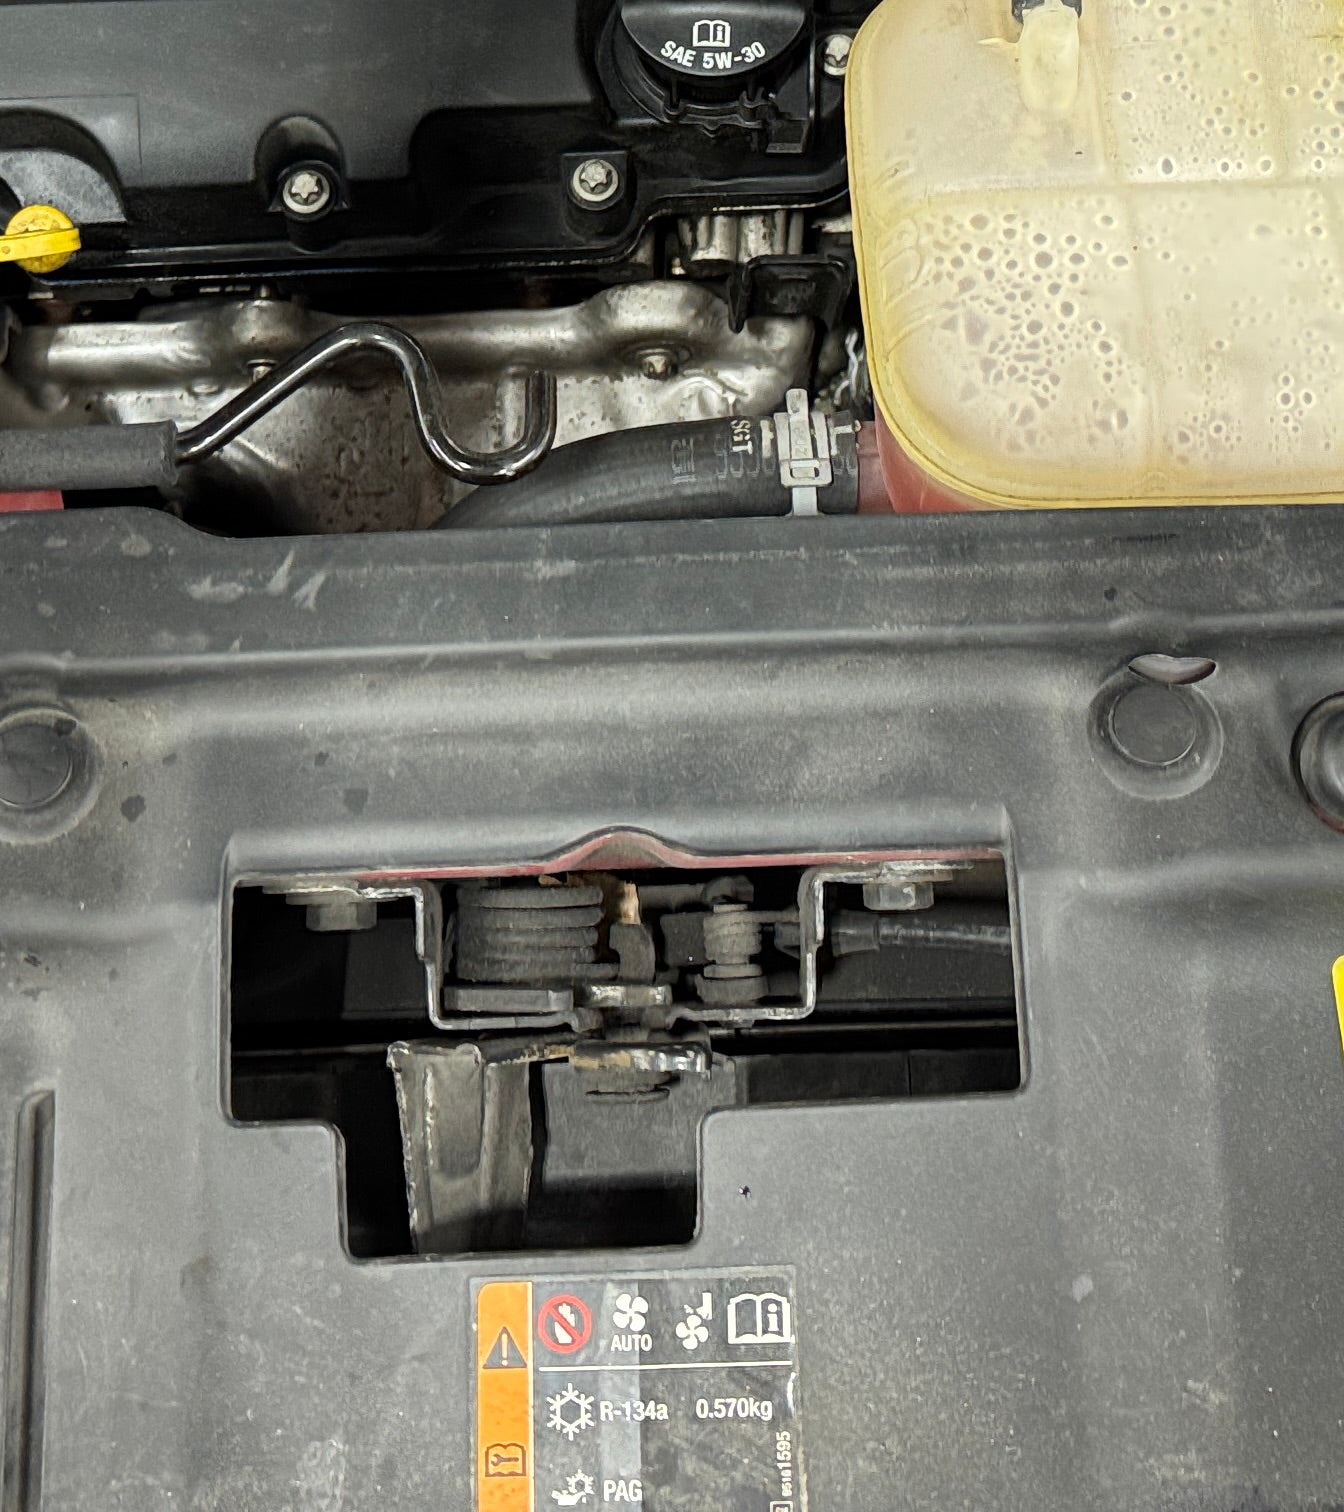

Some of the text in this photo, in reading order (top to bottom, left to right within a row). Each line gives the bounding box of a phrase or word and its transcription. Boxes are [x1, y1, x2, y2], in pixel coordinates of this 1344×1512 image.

[661, 40, 766, 69] SAE 5W-30
[611, 1334, 652, 1352] AUTO
[600, 1397, 773, 1421] R-134a 0.570kg
[604, 1481, 642, 1502] PAG
